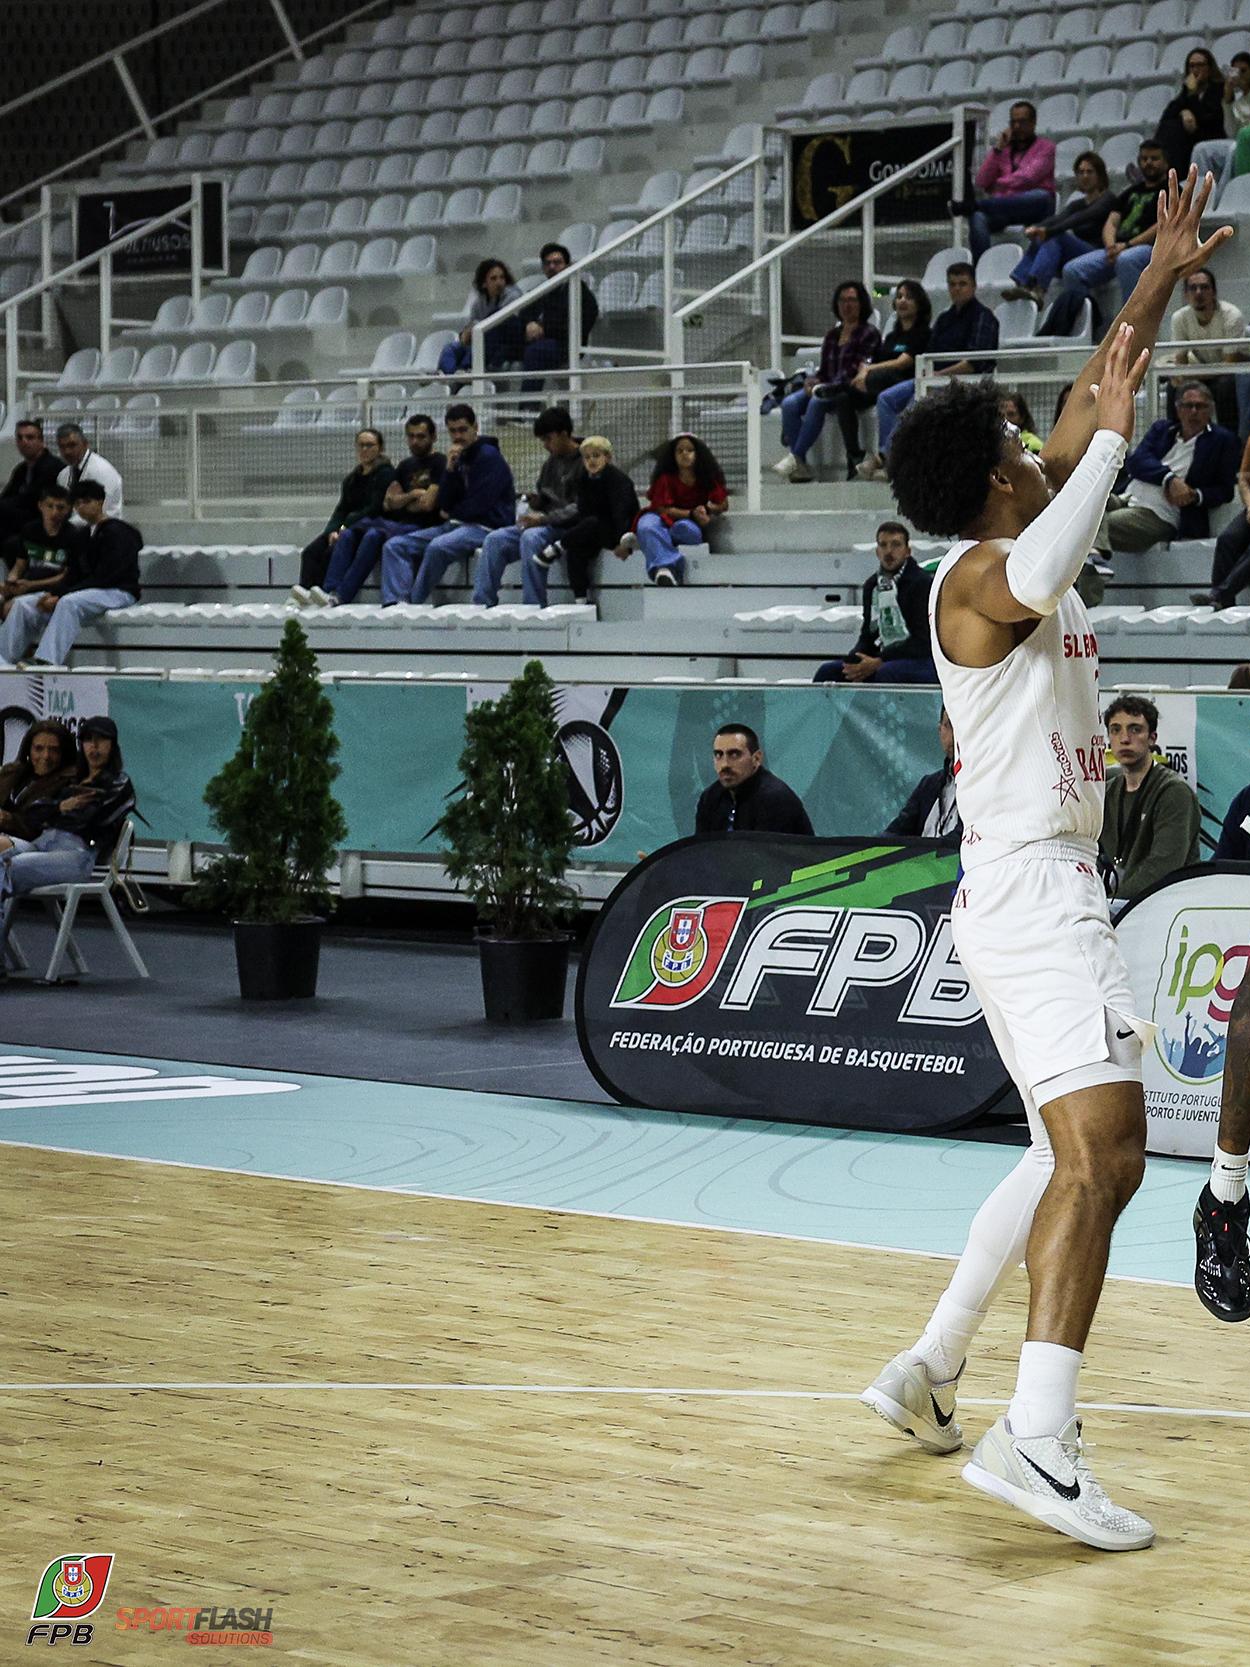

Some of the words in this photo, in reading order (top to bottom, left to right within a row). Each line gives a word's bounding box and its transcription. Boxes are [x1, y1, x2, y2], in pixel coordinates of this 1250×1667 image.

[719, 905, 985, 1027] FPB
[609, 1031, 705, 1058] FEDERAÇÃO
[707, 1037, 815, 1062] PORTUGUESA
[818, 1045, 843, 1065] DE
[844, 1048, 966, 1075] BASQUETEBOL
[1144, 1090, 1180, 1105] STITUTO
[1180, 1093, 1221, 1108] PORTUG
[1146, 1105, 1175, 1120] PORTO
[1175, 1108, 1182, 1120] E
[1182, 1109, 1220, 1123] JUVENTU
